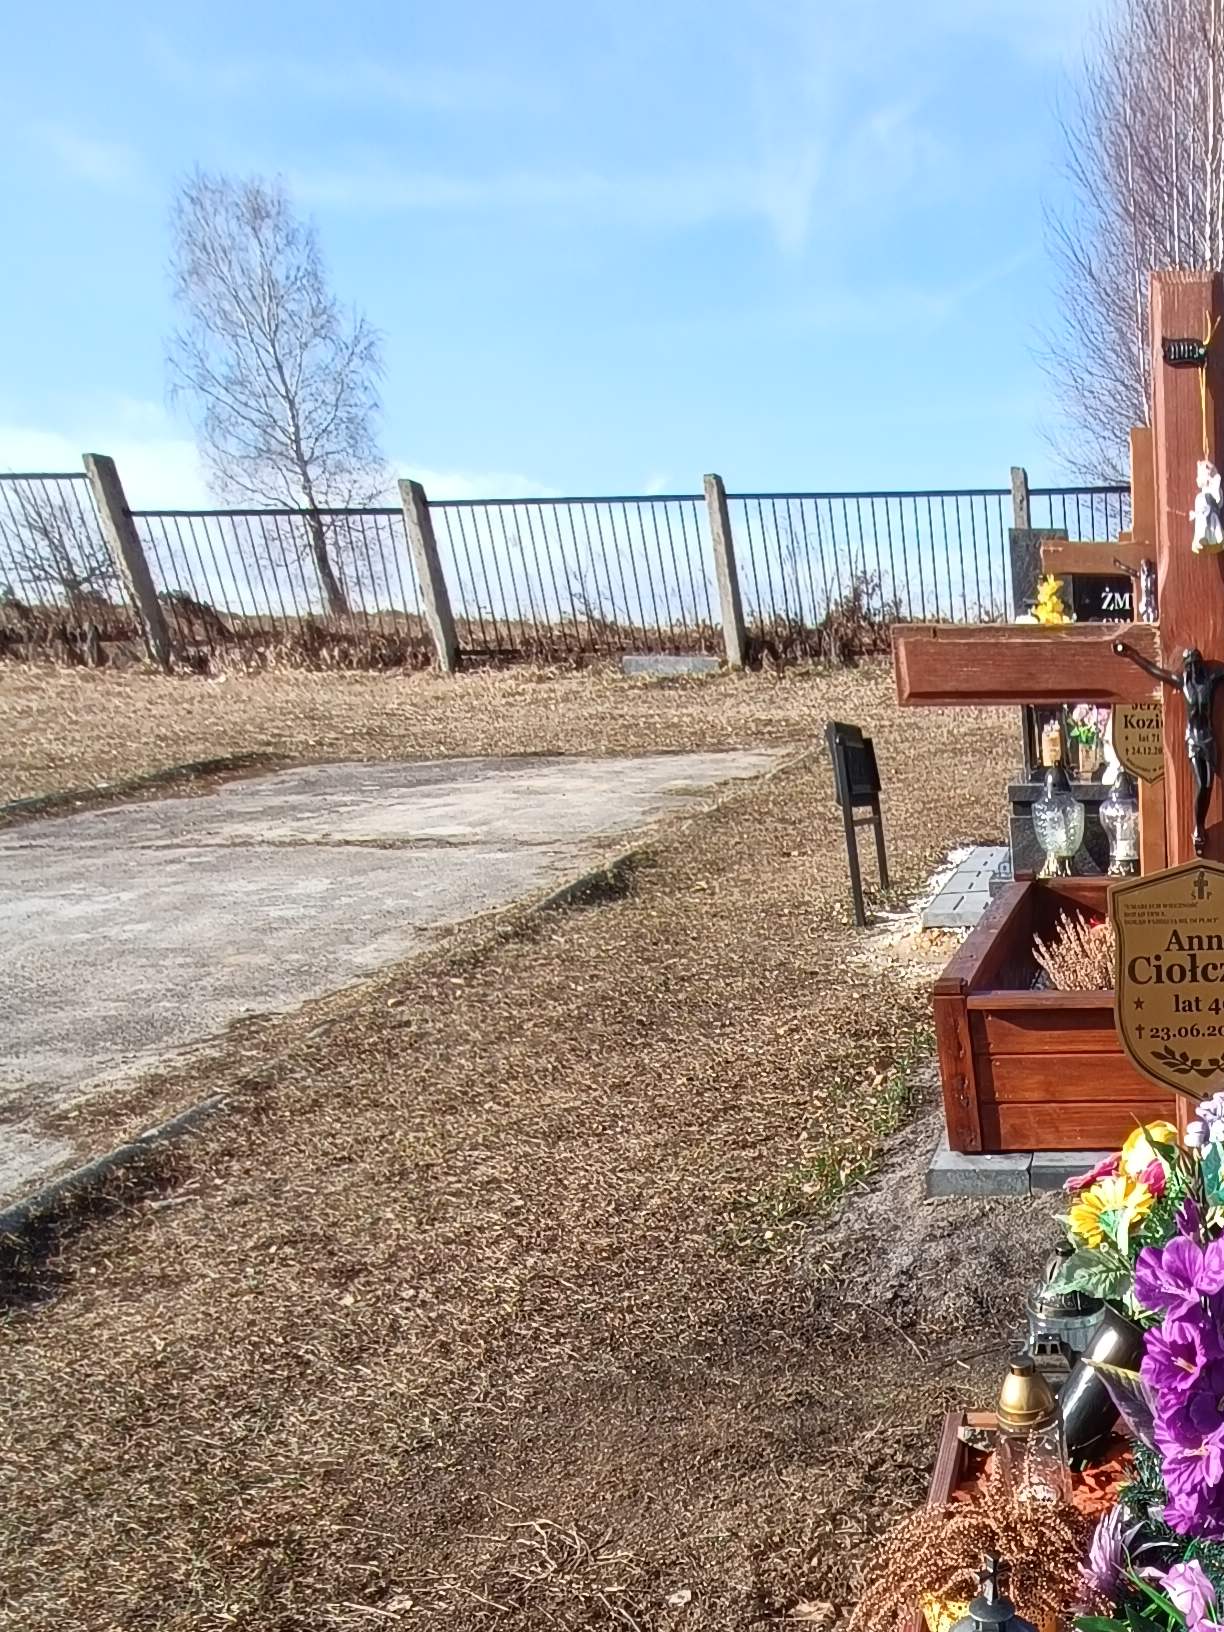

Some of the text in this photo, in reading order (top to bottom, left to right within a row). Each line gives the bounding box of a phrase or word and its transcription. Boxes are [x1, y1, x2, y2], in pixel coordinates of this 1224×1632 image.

[1101, 586, 1131, 611] ŻM
[1132, 746, 1163, 756] 24.12.20
[1173, 994, 1202, 1013] lat
